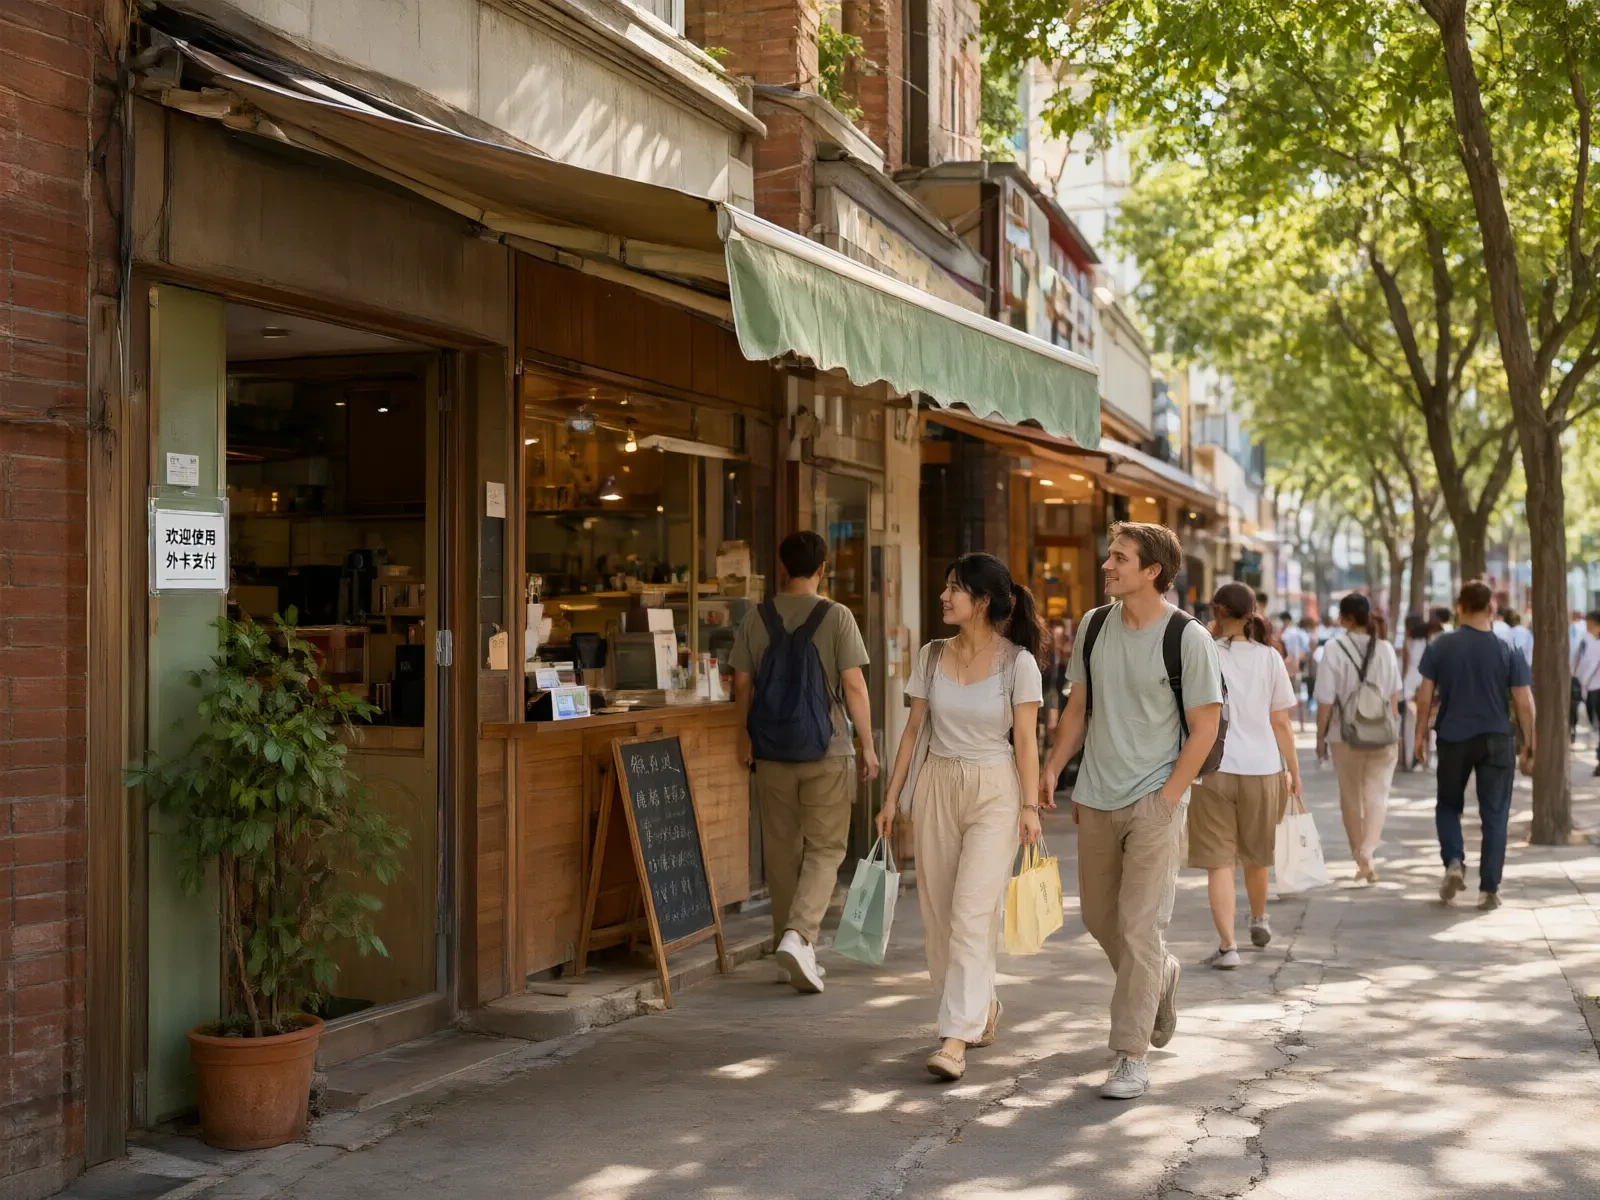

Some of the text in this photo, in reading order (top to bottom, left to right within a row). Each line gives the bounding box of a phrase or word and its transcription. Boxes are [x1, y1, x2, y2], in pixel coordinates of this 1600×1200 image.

[165, 528, 216, 546] 欢迎使用
[166, 551, 217, 570] 外卡支付
